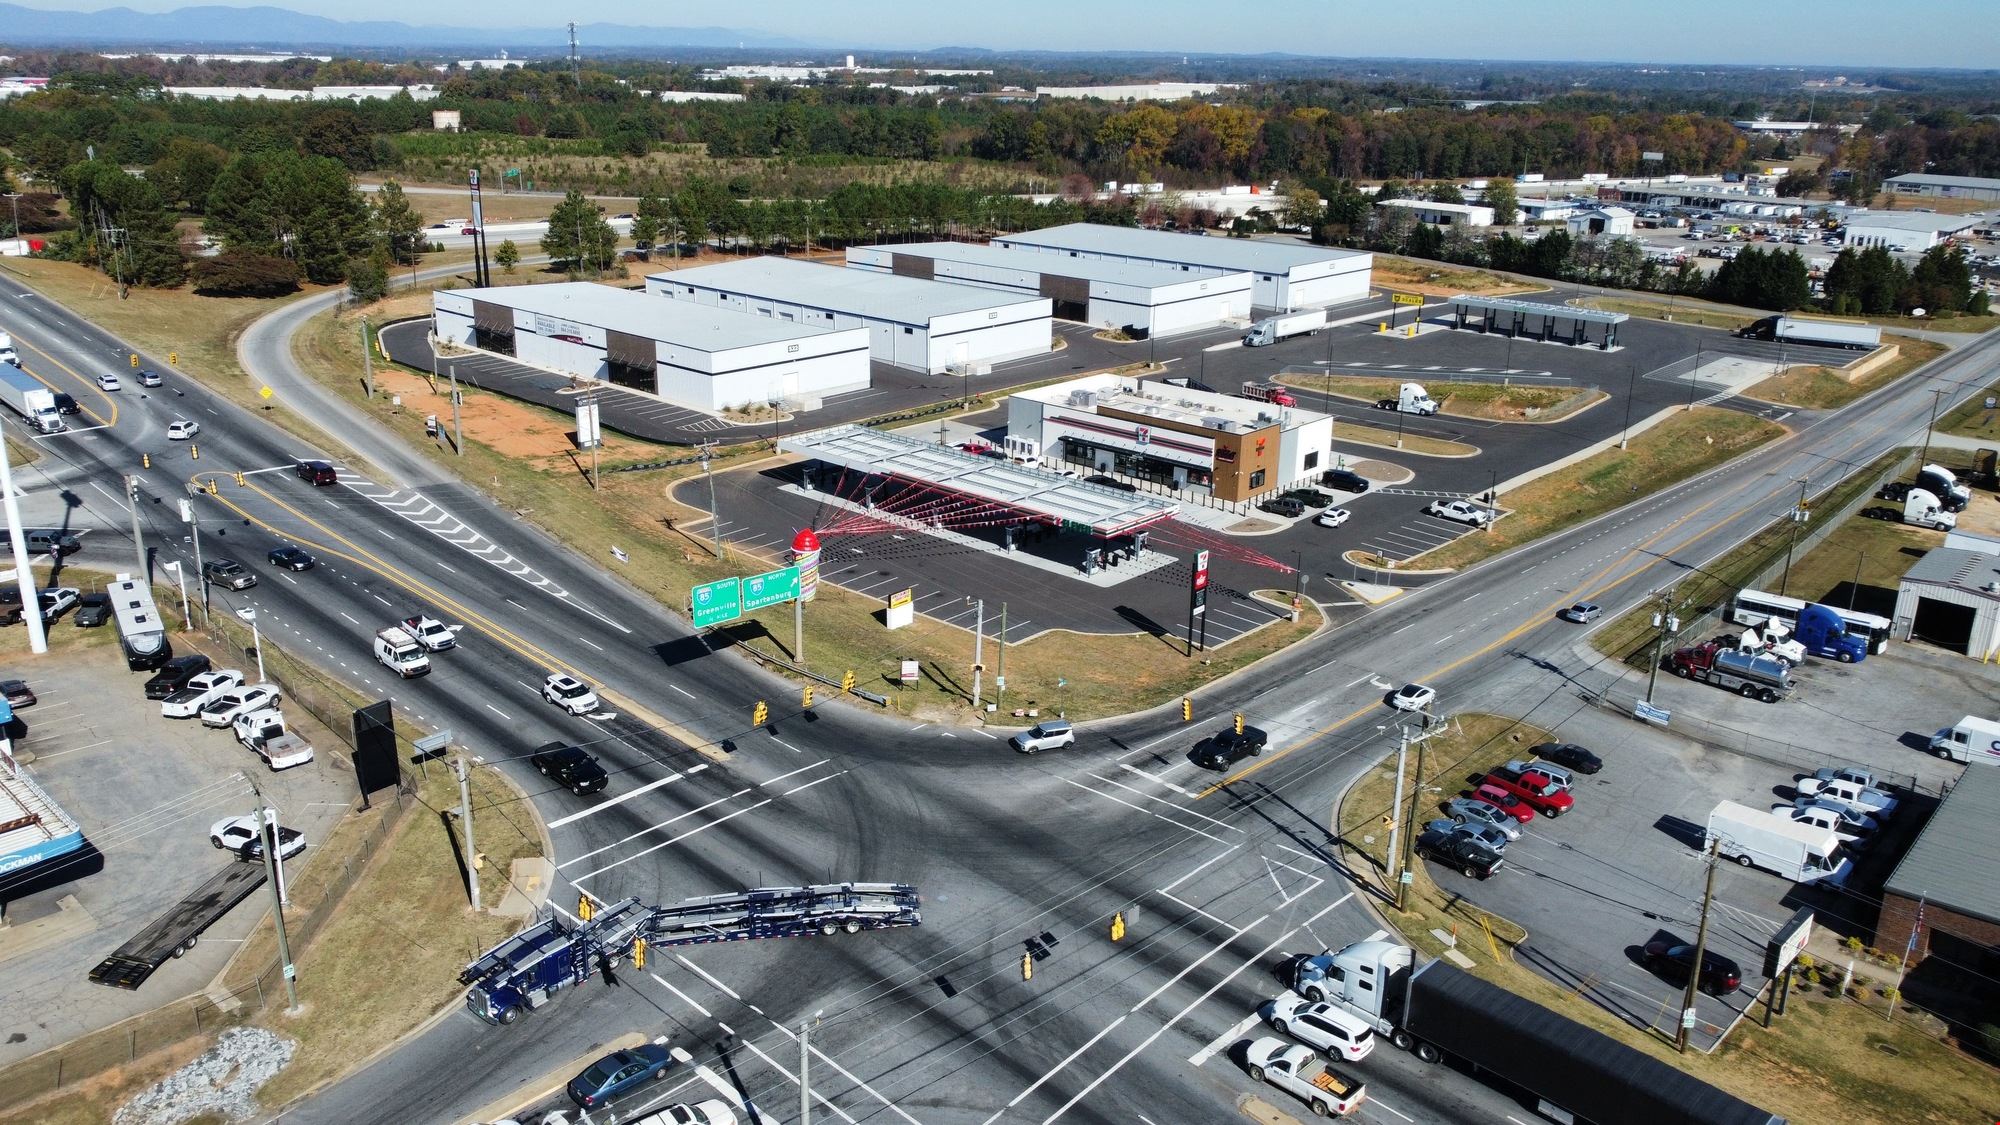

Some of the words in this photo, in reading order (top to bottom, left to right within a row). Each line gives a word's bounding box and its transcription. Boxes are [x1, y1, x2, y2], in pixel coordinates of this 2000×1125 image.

[768, 572, 787, 580] NORTH
[716, 581, 735, 590] SOUTH
[752, 583, 762, 592] 85
[699, 592, 709, 601] 85
[746, 591, 792, 607] Spartanburg
[697, 602, 737, 617] Greenville
